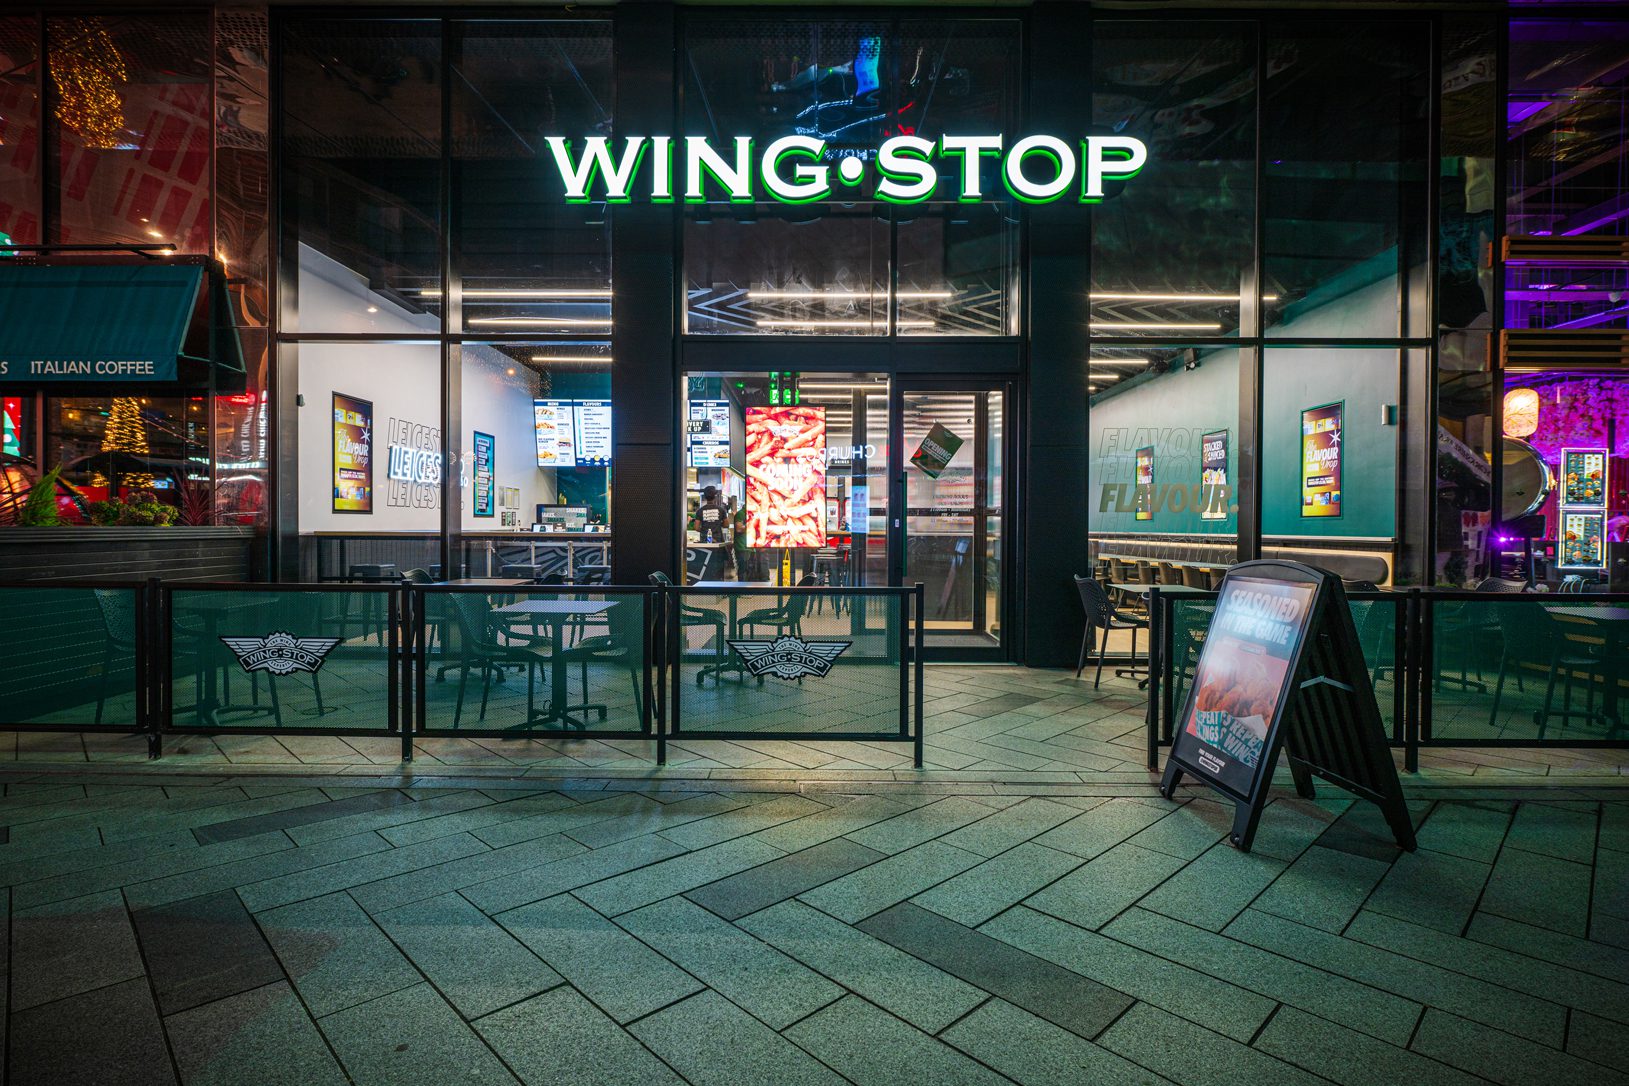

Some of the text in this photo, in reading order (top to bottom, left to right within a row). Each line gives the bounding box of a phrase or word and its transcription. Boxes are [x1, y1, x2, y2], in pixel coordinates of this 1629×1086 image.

[31, 361, 155, 375] ITALIAN COFFEE
[924, 437, 952, 460] OPENING
[1306, 446, 1339, 462] FLAVOUR
[1099, 483, 1239, 513] FLAVOUR.
[1226, 589, 1300, 623] SEASONED
[1255, 620, 1293, 646] GAME
